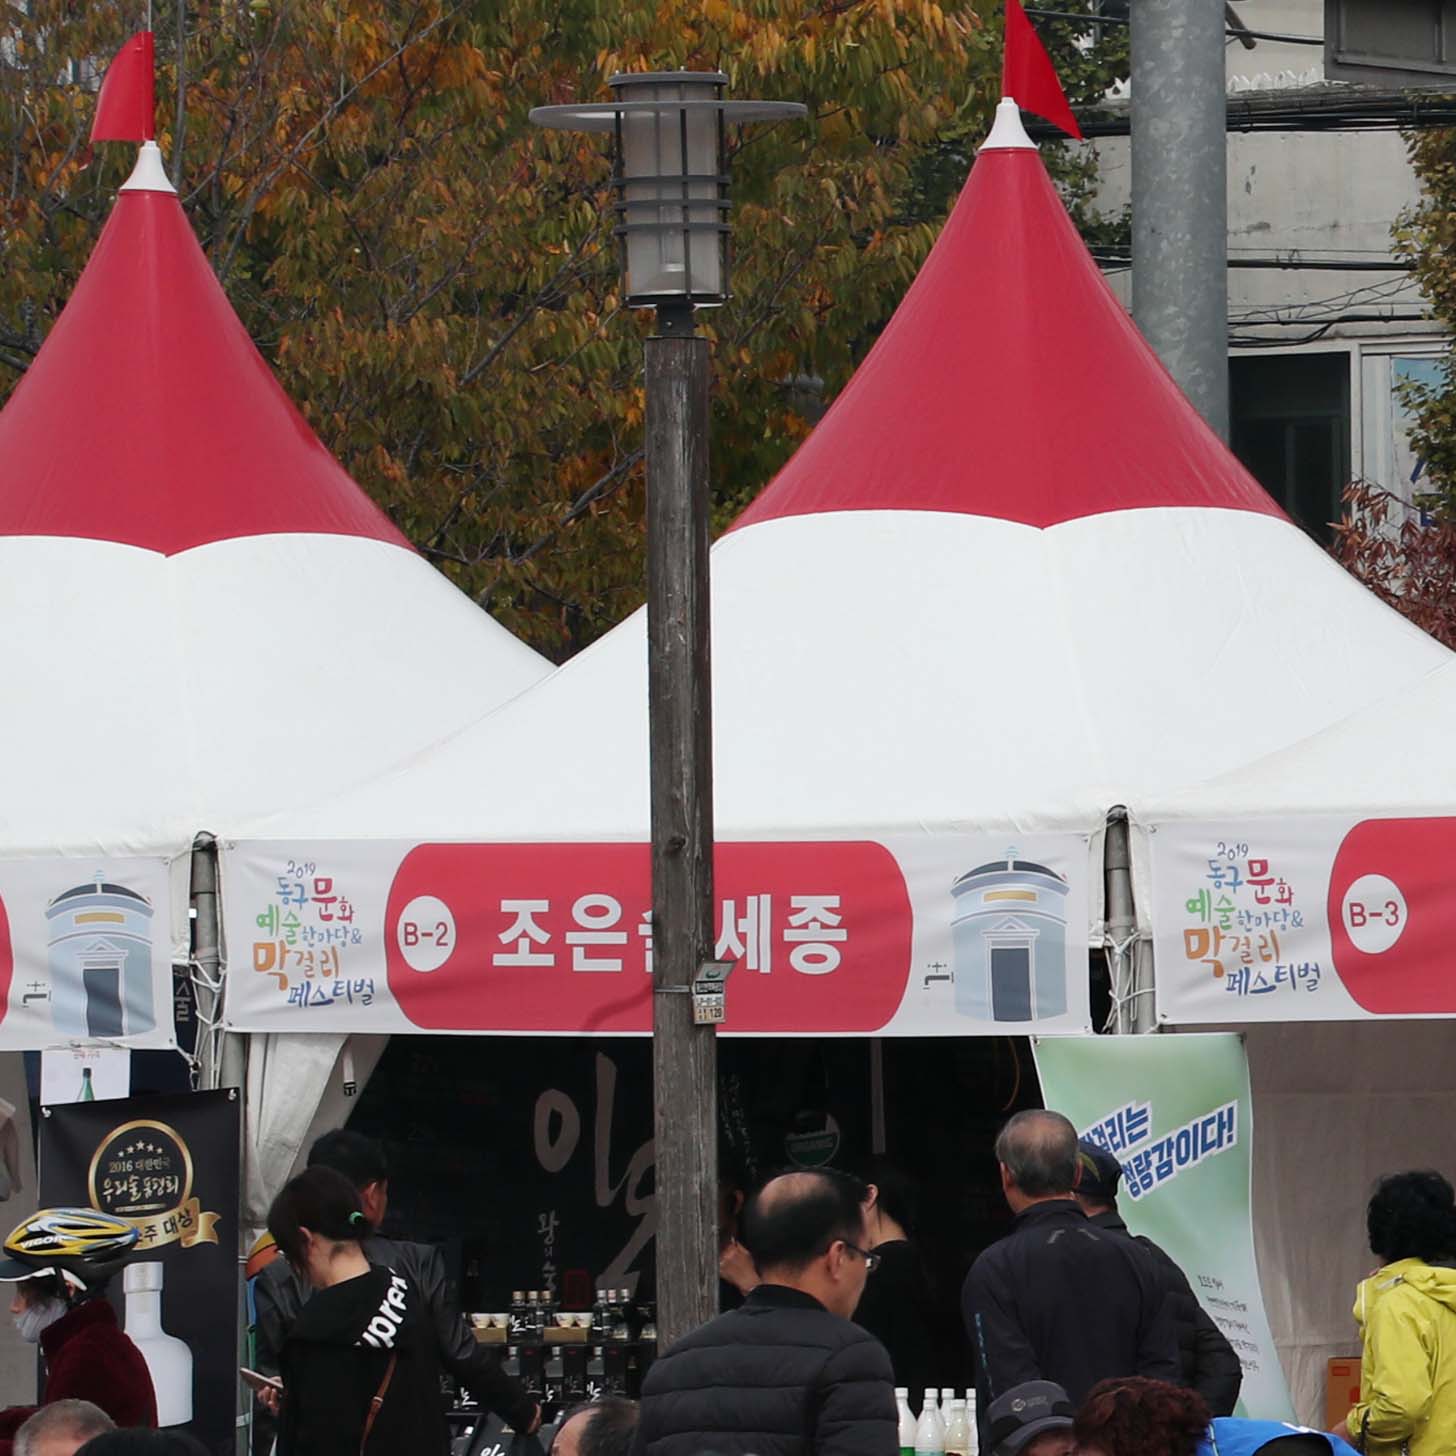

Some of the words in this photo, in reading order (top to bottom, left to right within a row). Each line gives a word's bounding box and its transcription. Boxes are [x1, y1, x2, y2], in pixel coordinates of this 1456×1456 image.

[1217, 842, 1249, 860] 2019
[287, 860, 317, 877] 2019
[1349, 901, 1399, 927] B-3
[403, 922, 449, 947] B-2
[1183, 925, 1281, 978] 막걸리
[253, 940, 339, 990] 막걸리
[1226, 962, 1321, 995] 페스티벌
[288, 979, 375, 1008] 페스티벌
[109, 1159, 133, 1172] 2016
[163, 1208, 194, 1235] 대상
